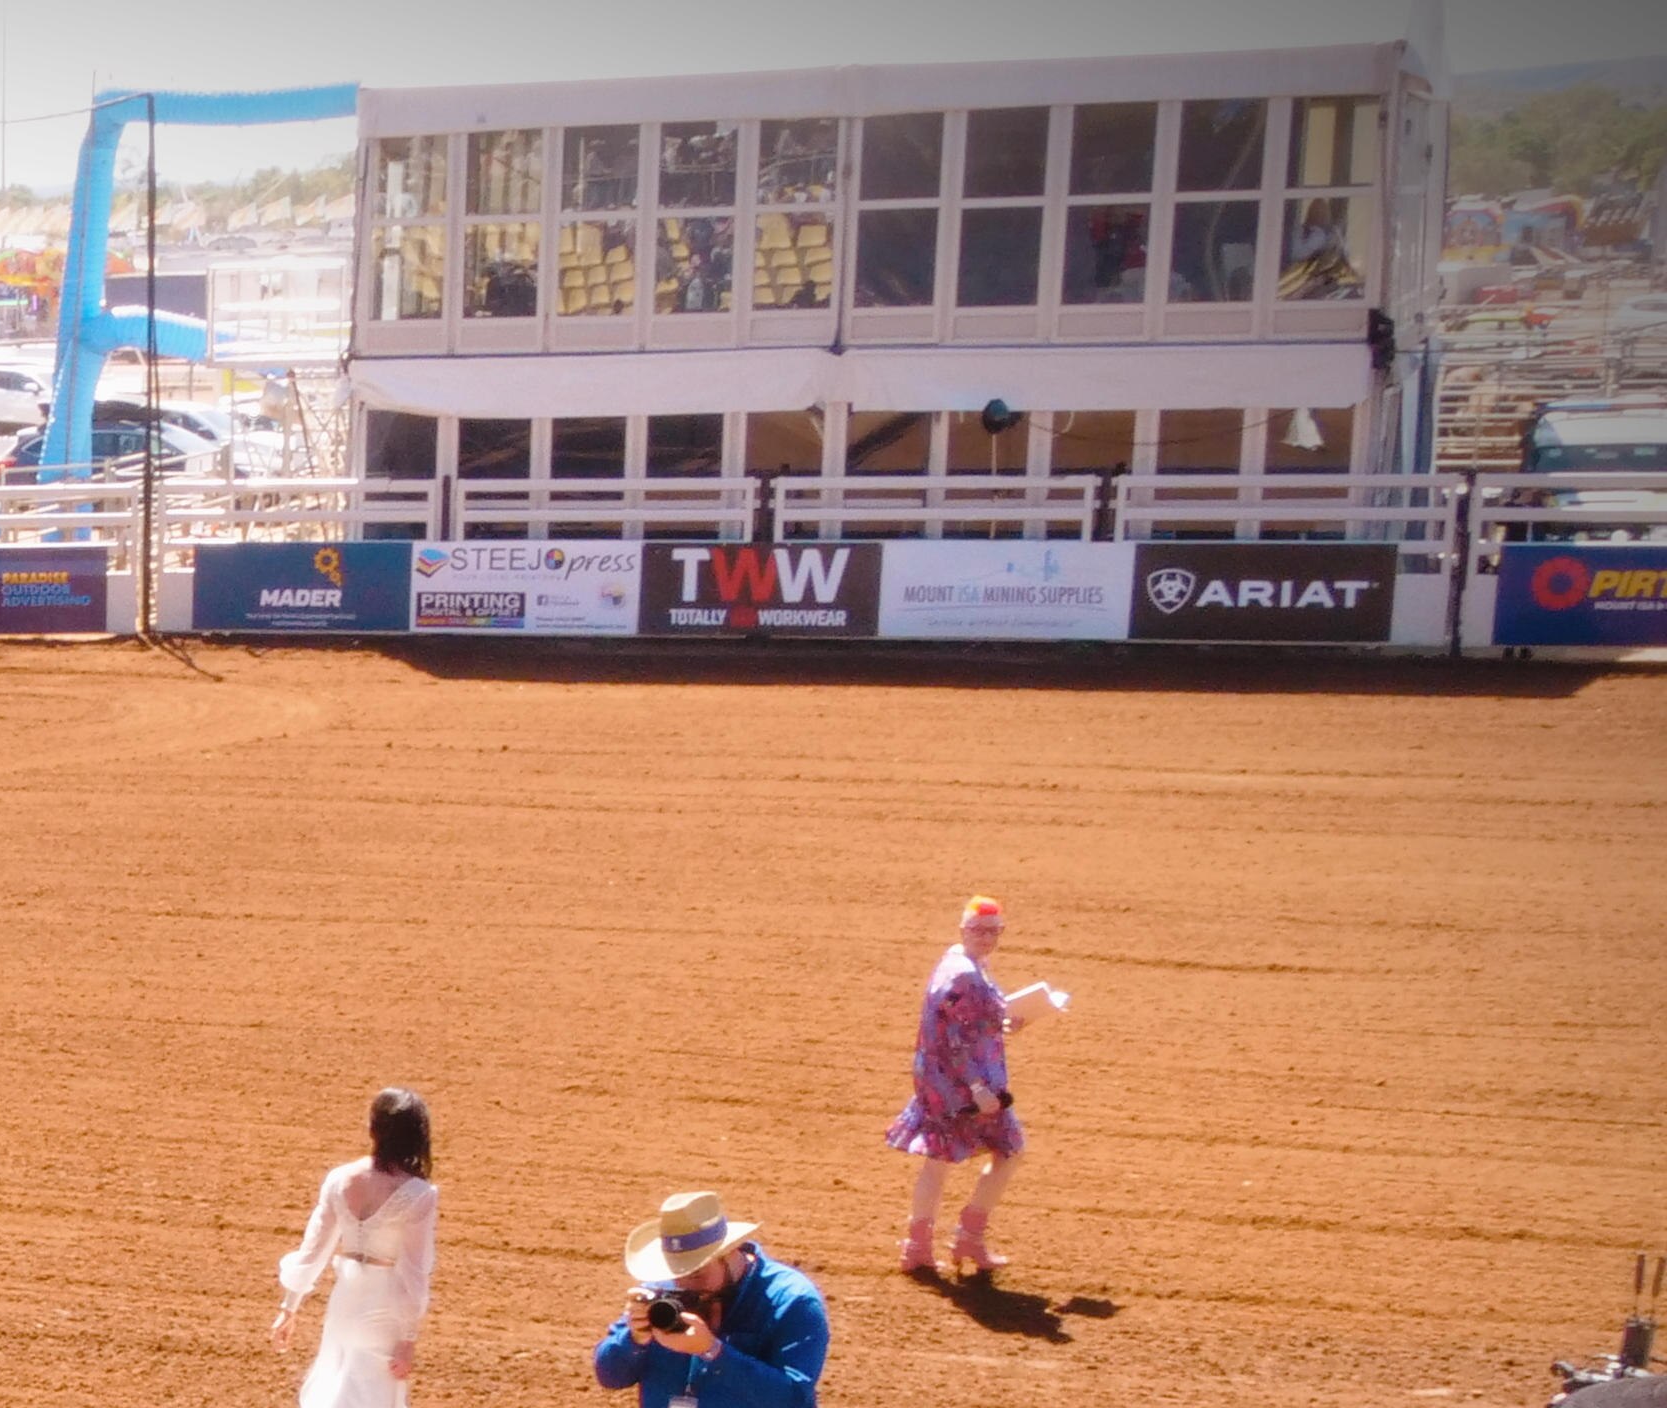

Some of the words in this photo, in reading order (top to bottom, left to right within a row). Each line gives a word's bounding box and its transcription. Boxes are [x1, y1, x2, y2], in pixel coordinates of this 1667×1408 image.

[564, 552, 637, 581] press
[671, 547, 851, 604] TWW
[259, 588, 343, 608] MADER
[420, 593, 521, 608] PRINTING
[904, 585, 955, 604] MOUNT
[983, 586, 1037, 604] MINING
[1039, 586, 1104, 605] SUPPLIES
[1195, 579, 1370, 609] ARIAT
[670, 608, 727, 626] TOTALLY
[757, 609, 847, 627] WORKWEAR
